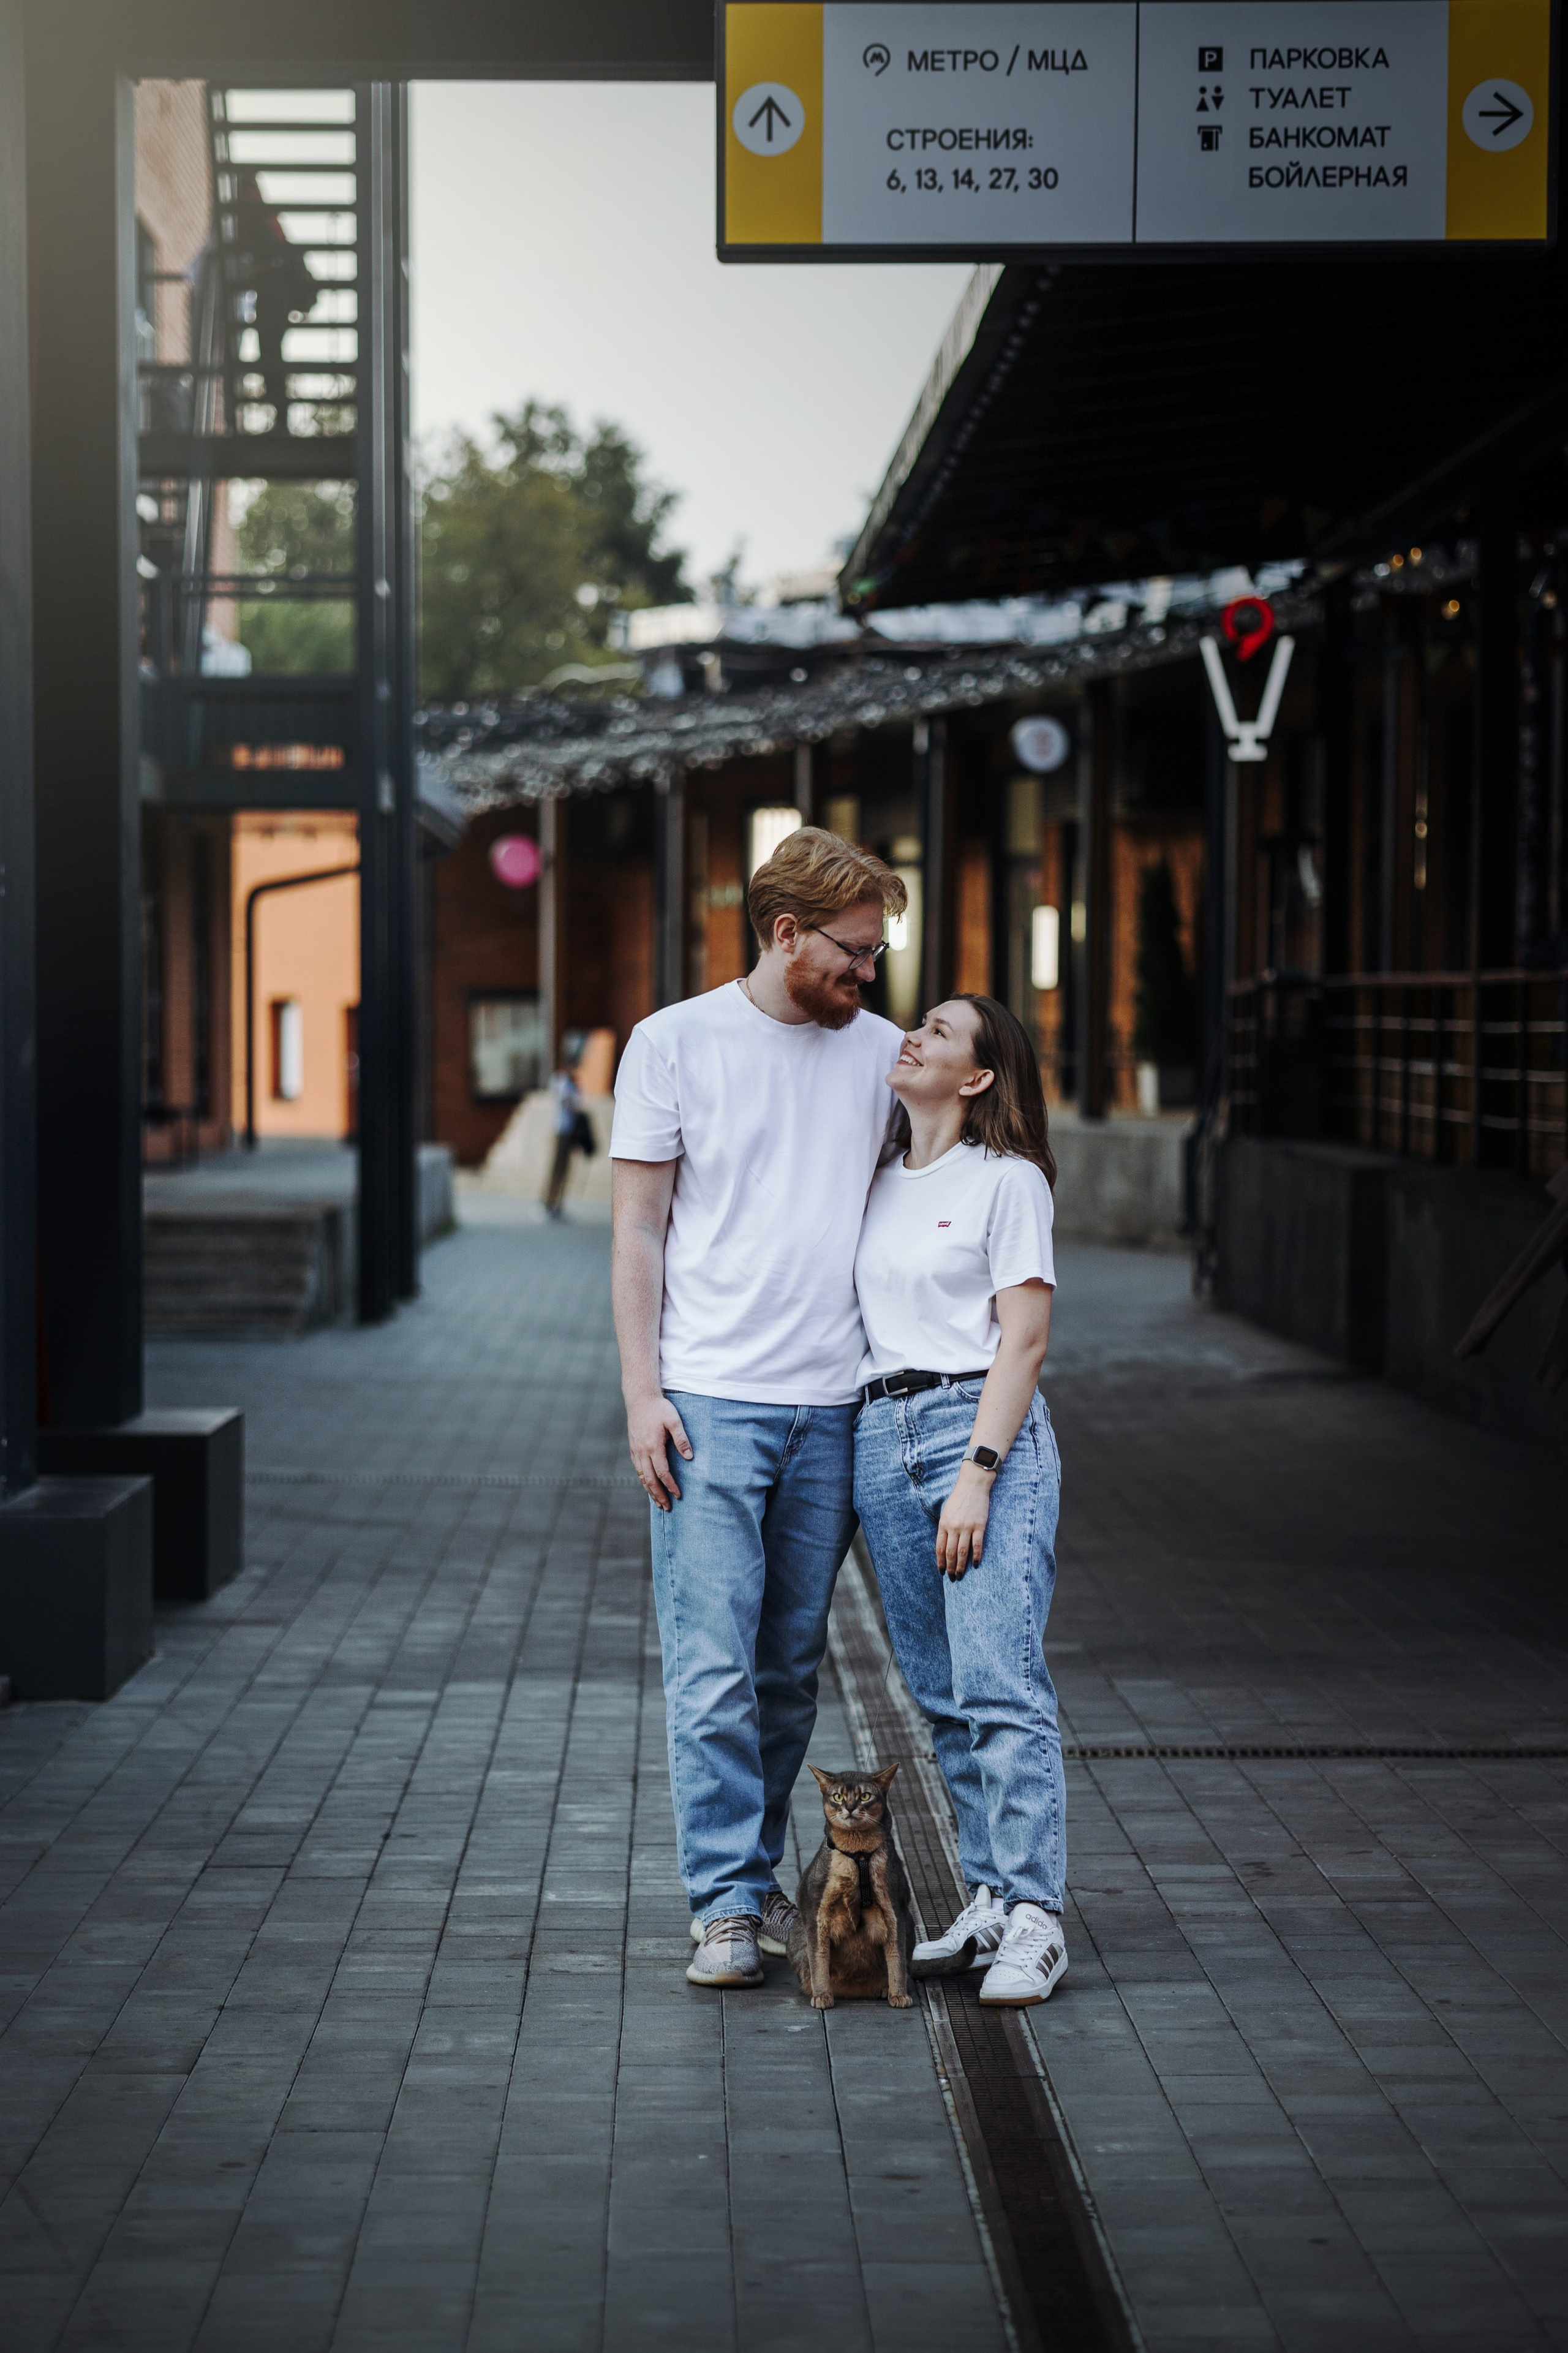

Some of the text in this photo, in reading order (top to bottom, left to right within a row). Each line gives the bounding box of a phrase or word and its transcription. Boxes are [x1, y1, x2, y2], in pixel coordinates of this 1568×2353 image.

[907, 49, 1000, 72] МЕТРО
[1028, 49, 1088, 75] МЦД
[1250, 47, 1390, 70] ПАРКОВКА
[1249, 86, 1352, 110] ТУАЛЕТ
[886, 127, 1034, 151] СТРОЕНИЯ:
[1249, 126, 1392, 149] БАНКОМАТ
[886, 167, 1059, 193] 6, 13, 14, 27, 30
[1248, 161, 1408, 189] БОЙЛЕРНАЯ
[1025, 1913, 1048, 1930] adida
